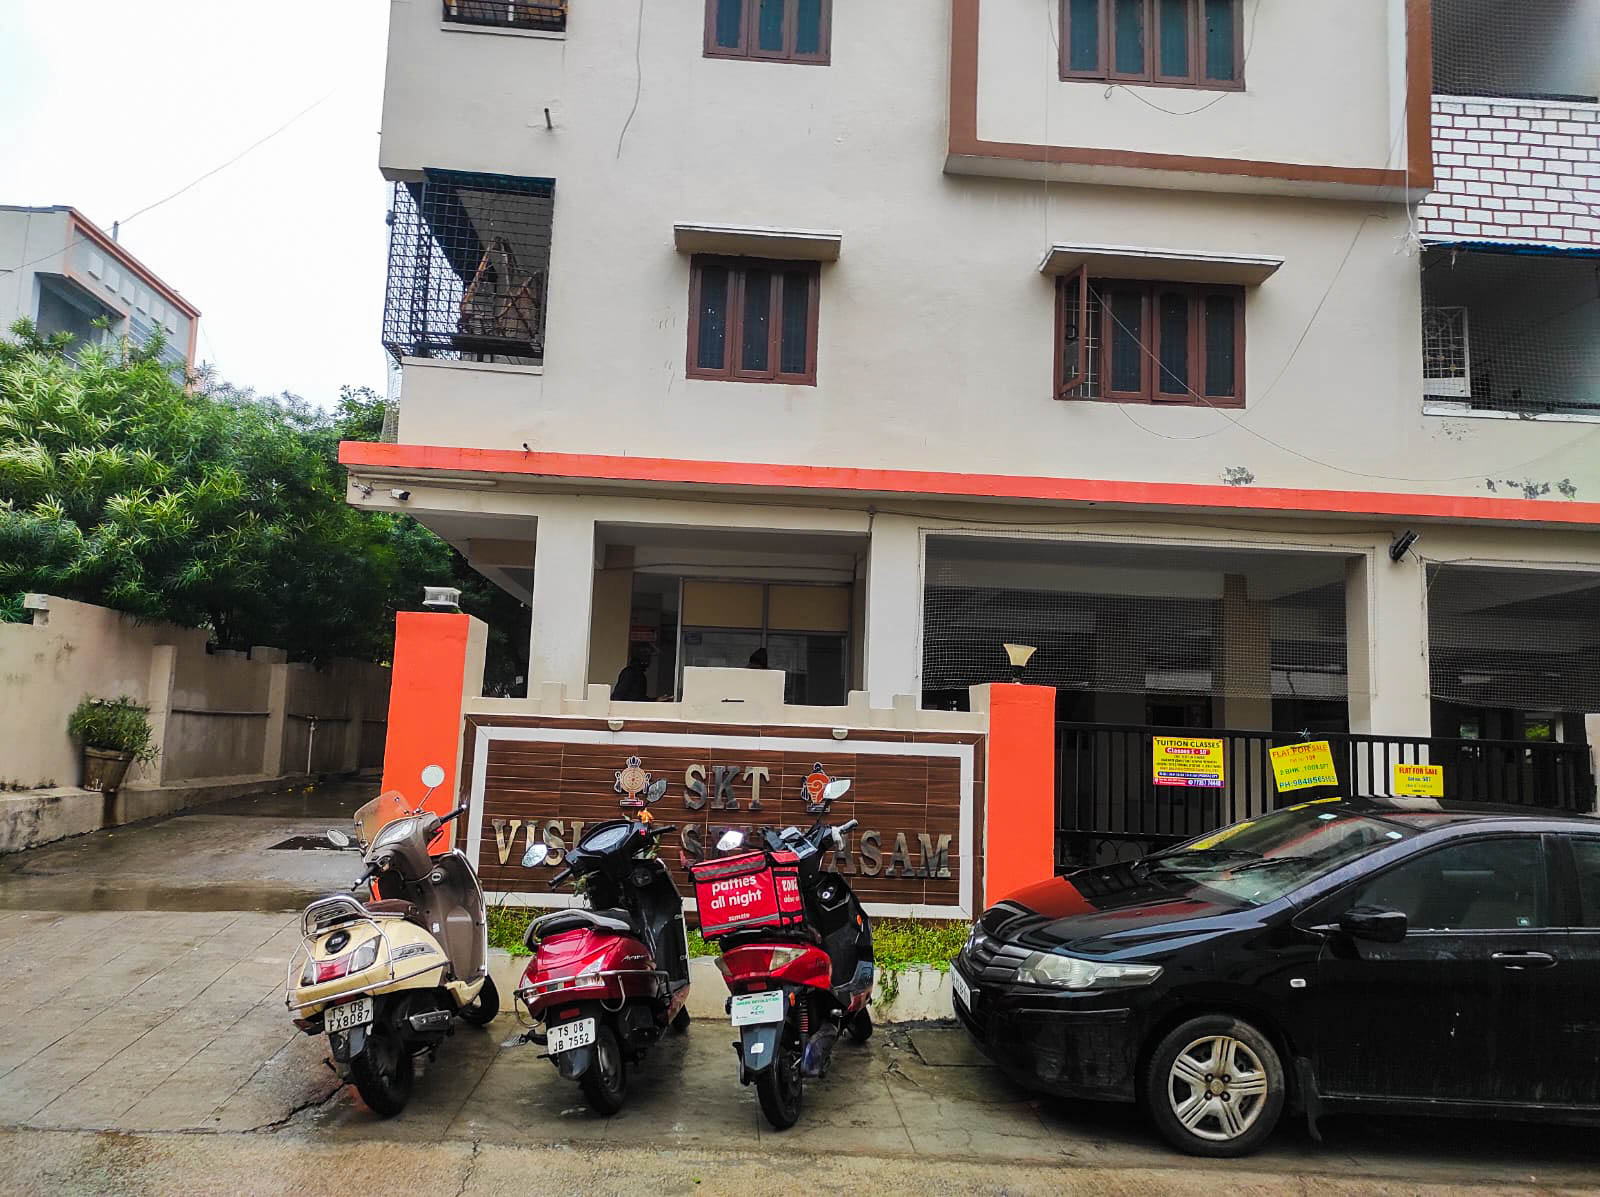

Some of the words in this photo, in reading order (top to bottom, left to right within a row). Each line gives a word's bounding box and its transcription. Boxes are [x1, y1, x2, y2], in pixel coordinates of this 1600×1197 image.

[1156, 739, 1188, 748] TUITION
[1190, 741, 1220, 749] CLASSES
[1272, 750, 1290, 758] FLAT
[1293, 745, 1311, 754] FOR
[1312, 743, 1329, 752] SALE
[1399, 767, 1411, 775] FLAT
[1413, 767, 1423, 775] FOR
[1425, 768, 1438, 776] SALE
[684, 764, 770, 811] SKT
[712, 875, 758, 896] patties
[711, 896, 726, 910] all
[728, 889, 762, 907] night
[331, 1006, 344, 1017] TS
[350, 1000, 364, 1013] 08
[558, 1027, 569, 1036] TS
[573, 1022, 584, 1033] 08
[554, 1040, 564, 1052] JB
[569, 1032, 589, 1046] 7552
